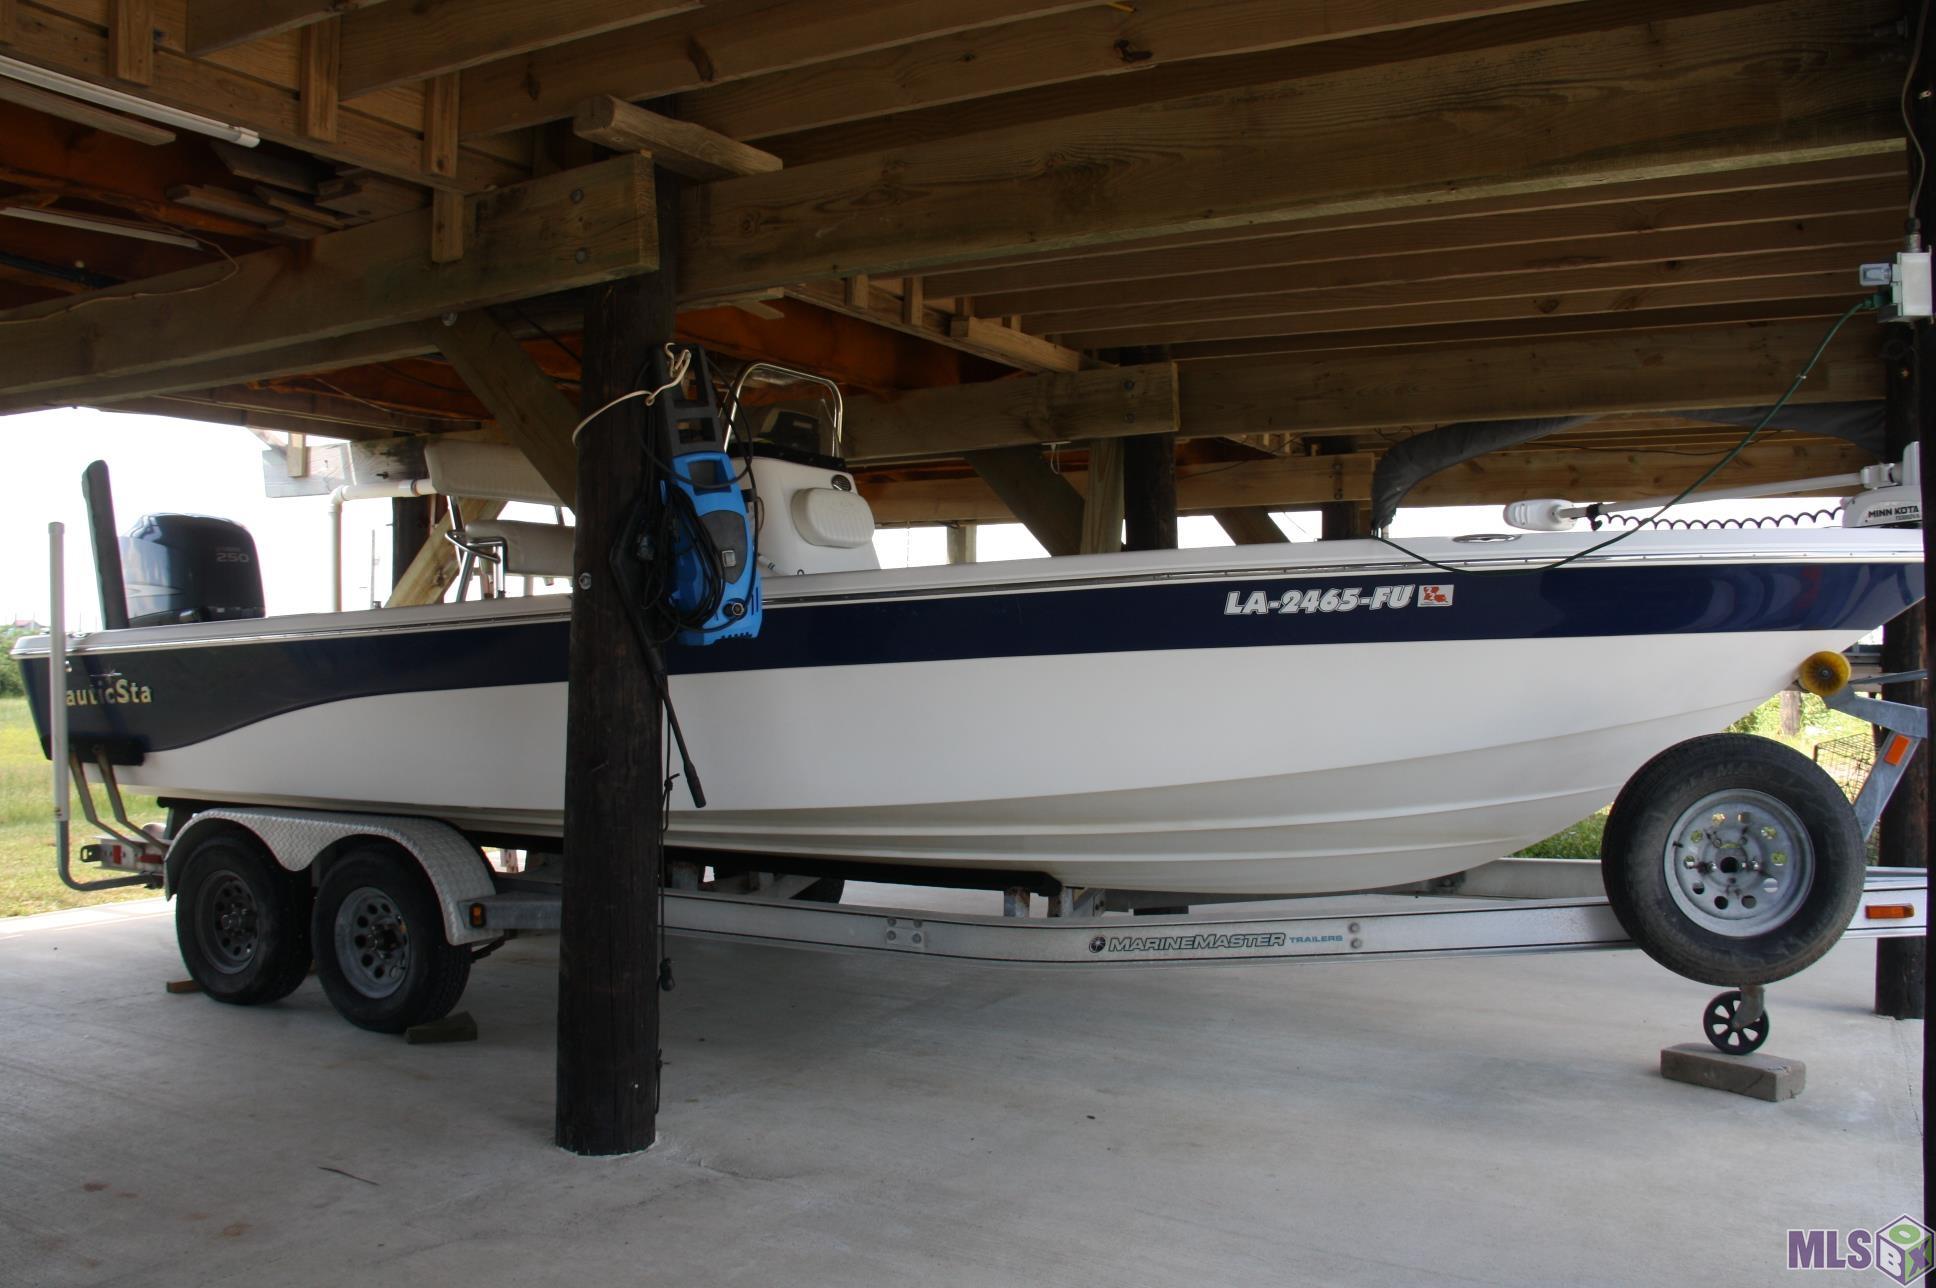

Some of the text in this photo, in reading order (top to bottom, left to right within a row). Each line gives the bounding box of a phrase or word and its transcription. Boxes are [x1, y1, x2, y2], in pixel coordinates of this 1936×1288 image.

[1868, 508, 1893, 518] MINN
[1894, 505, 1919, 515] KOTA
[216, 552, 249, 563] 250
[1224, 584, 1416, 615] LA-2465-FU
[66, 678, 152, 706] auticSta
[1289, 934, 1344, 944] TRAILERS
